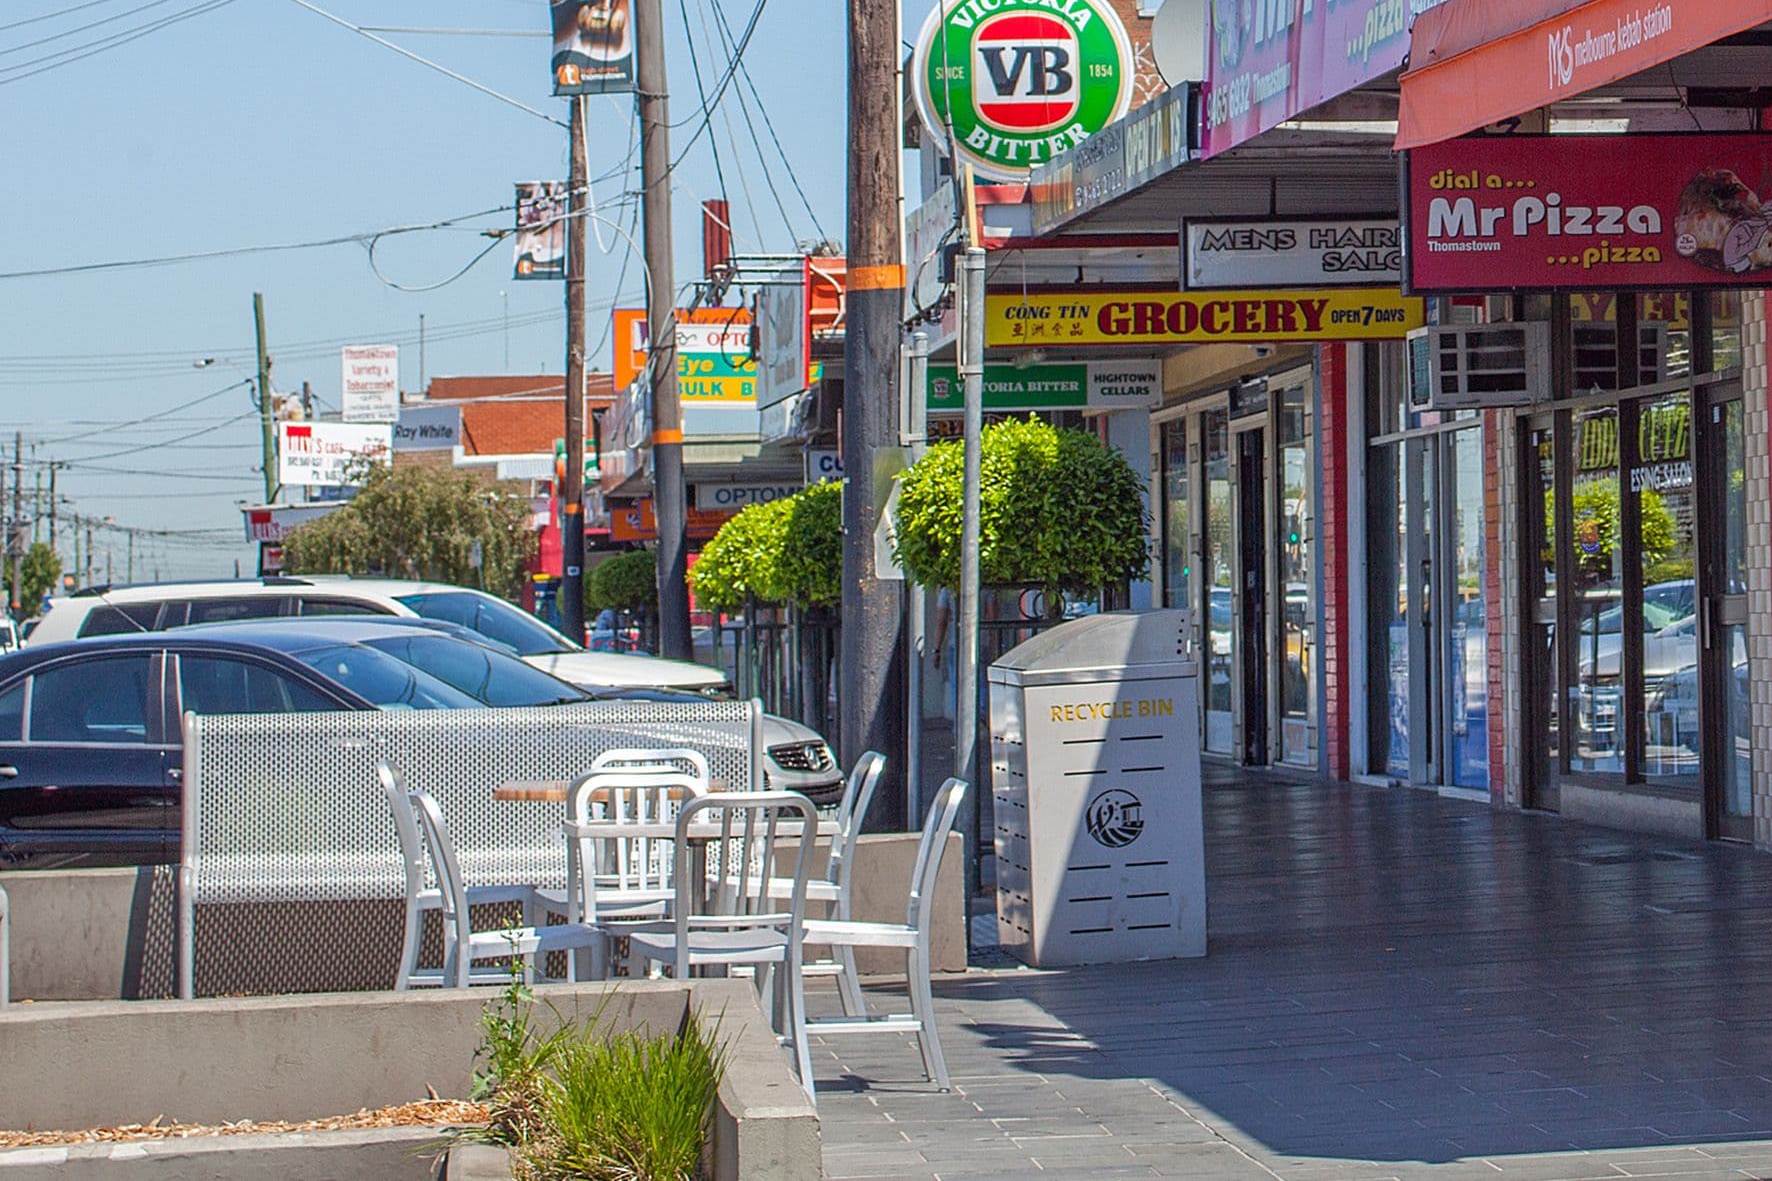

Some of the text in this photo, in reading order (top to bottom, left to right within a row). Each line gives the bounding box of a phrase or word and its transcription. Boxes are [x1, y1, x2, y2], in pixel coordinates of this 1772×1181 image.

[1575, 29, 1616, 67] melbourne
[1617, 9, 1642, 52] kebab
[1643, 1, 1672, 41] station
[935, 64, 1113, 80] SINCE 1854
[977, 45, 1074, 97] VB
[964, 121, 1091, 160] BITTER
[1429, 169, 1480, 190] dial
[1200, 226, 1400, 251] MENS HAIR
[1427, 240, 1501, 253] Thomastown
[1058, 301, 1091, 319] TÍN
[1097, 298, 1405, 337] GROCERY OPEN 7 DAYS
[956, 381, 1024, 393] VTORIA
[1028, 380, 1079, 392] BITTER
[1093, 373, 1156, 385] HIGHTOWN
[1100, 385, 1150, 397] CELLARS
[395, 424, 454, 441] Ray White
[1050, 697, 1174, 723] RECYCLE BIN
